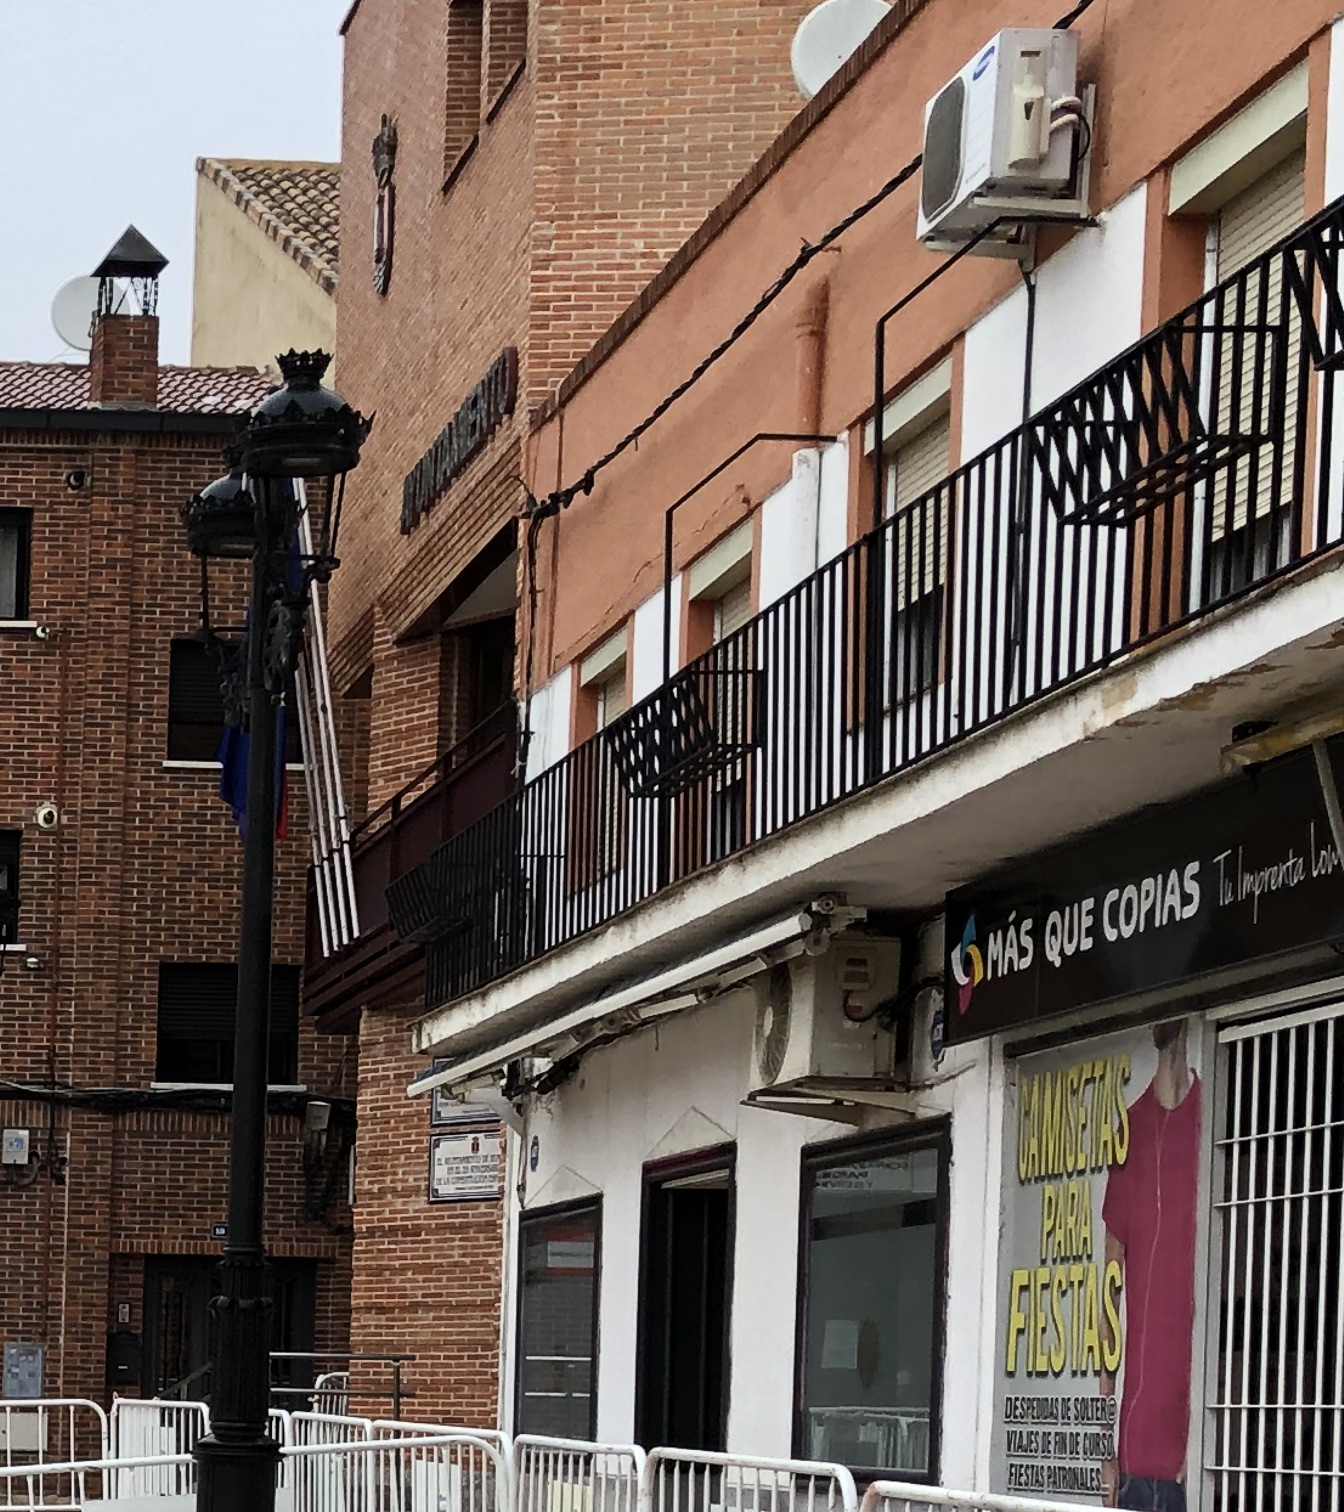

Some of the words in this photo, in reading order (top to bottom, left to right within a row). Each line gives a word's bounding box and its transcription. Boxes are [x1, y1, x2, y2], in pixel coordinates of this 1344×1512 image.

[987, 910, 1033, 981] MÁS
[1044, 896, 1096, 968] QUE
[1102, 860, 1200, 942] COPIAS
[1213, 849, 1234, 906] Tu
[1237, 845, 1306, 924] Imprenta
[1018, 1054, 1132, 1185] CAMISETAS
[1041, 1179, 1092, 1263] PARA
[1006, 1259, 1123, 1376] FIESTAS
[1006, 1430, 1039, 1453] VIAJES
[1042, 1431, 1052, 1454] DE
[1054, 1431, 1067, 1455] FIN
[1069, 1431, 1081, 1456] DE
[1083, 1432, 1114, 1457] CURSO
[1061, 1397, 1071, 1421] DE
[1008, 1463, 1044, 1487] FIESTAS
